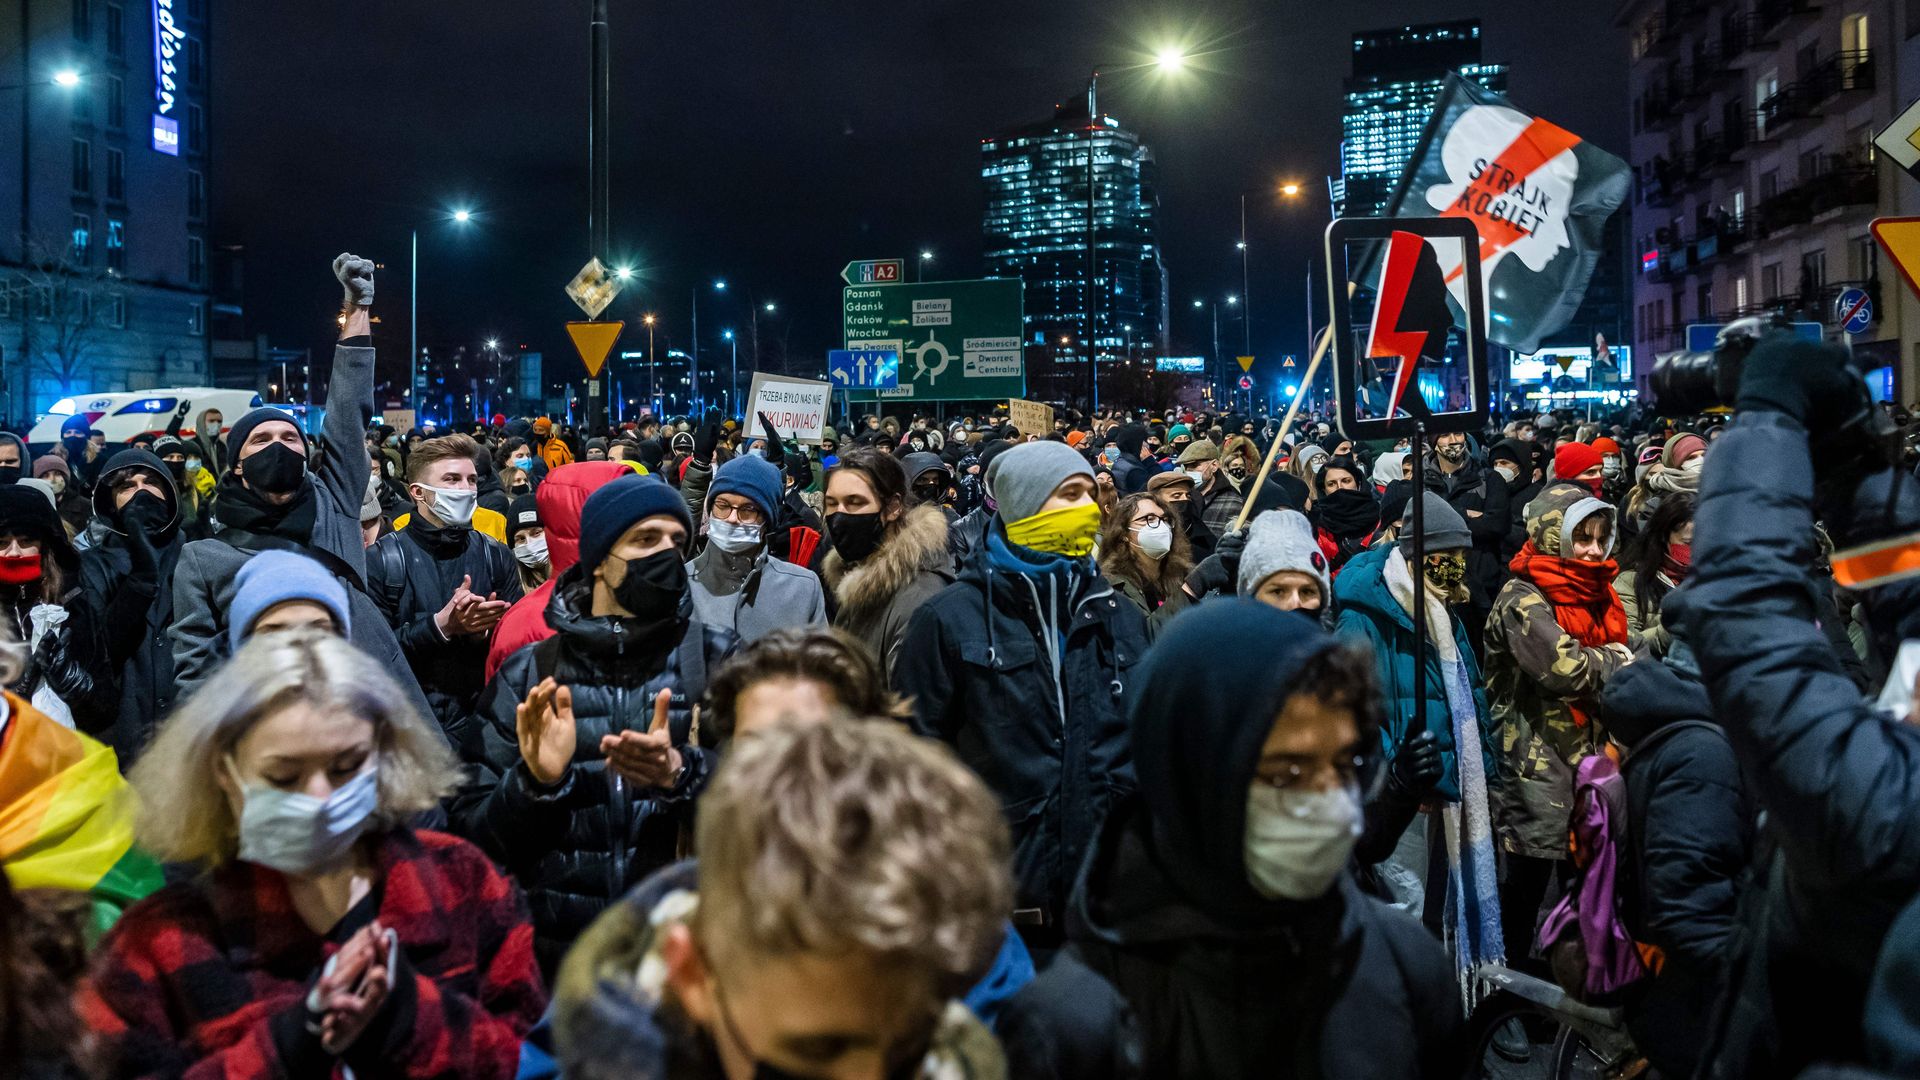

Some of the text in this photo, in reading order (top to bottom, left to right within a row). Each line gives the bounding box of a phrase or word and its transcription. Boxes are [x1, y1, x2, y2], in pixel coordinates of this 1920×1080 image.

[1469, 158, 1552, 216] STRAJK
[1457, 186, 1544, 239] KOBIET
[876, 266, 894, 279] A2
[846, 288, 882, 299] Poznań
[846, 301, 884, 311] Gdańsk
[916, 302, 947, 311] Bielany
[846, 315, 883, 325] Kraków
[846, 328, 889, 338] Wrocław
[978, 354, 1014, 362] Dworzec
[978, 365, 1020, 374] Centralny
[760, 390, 822, 405] TRZEBA BYŁO NAS NIE
